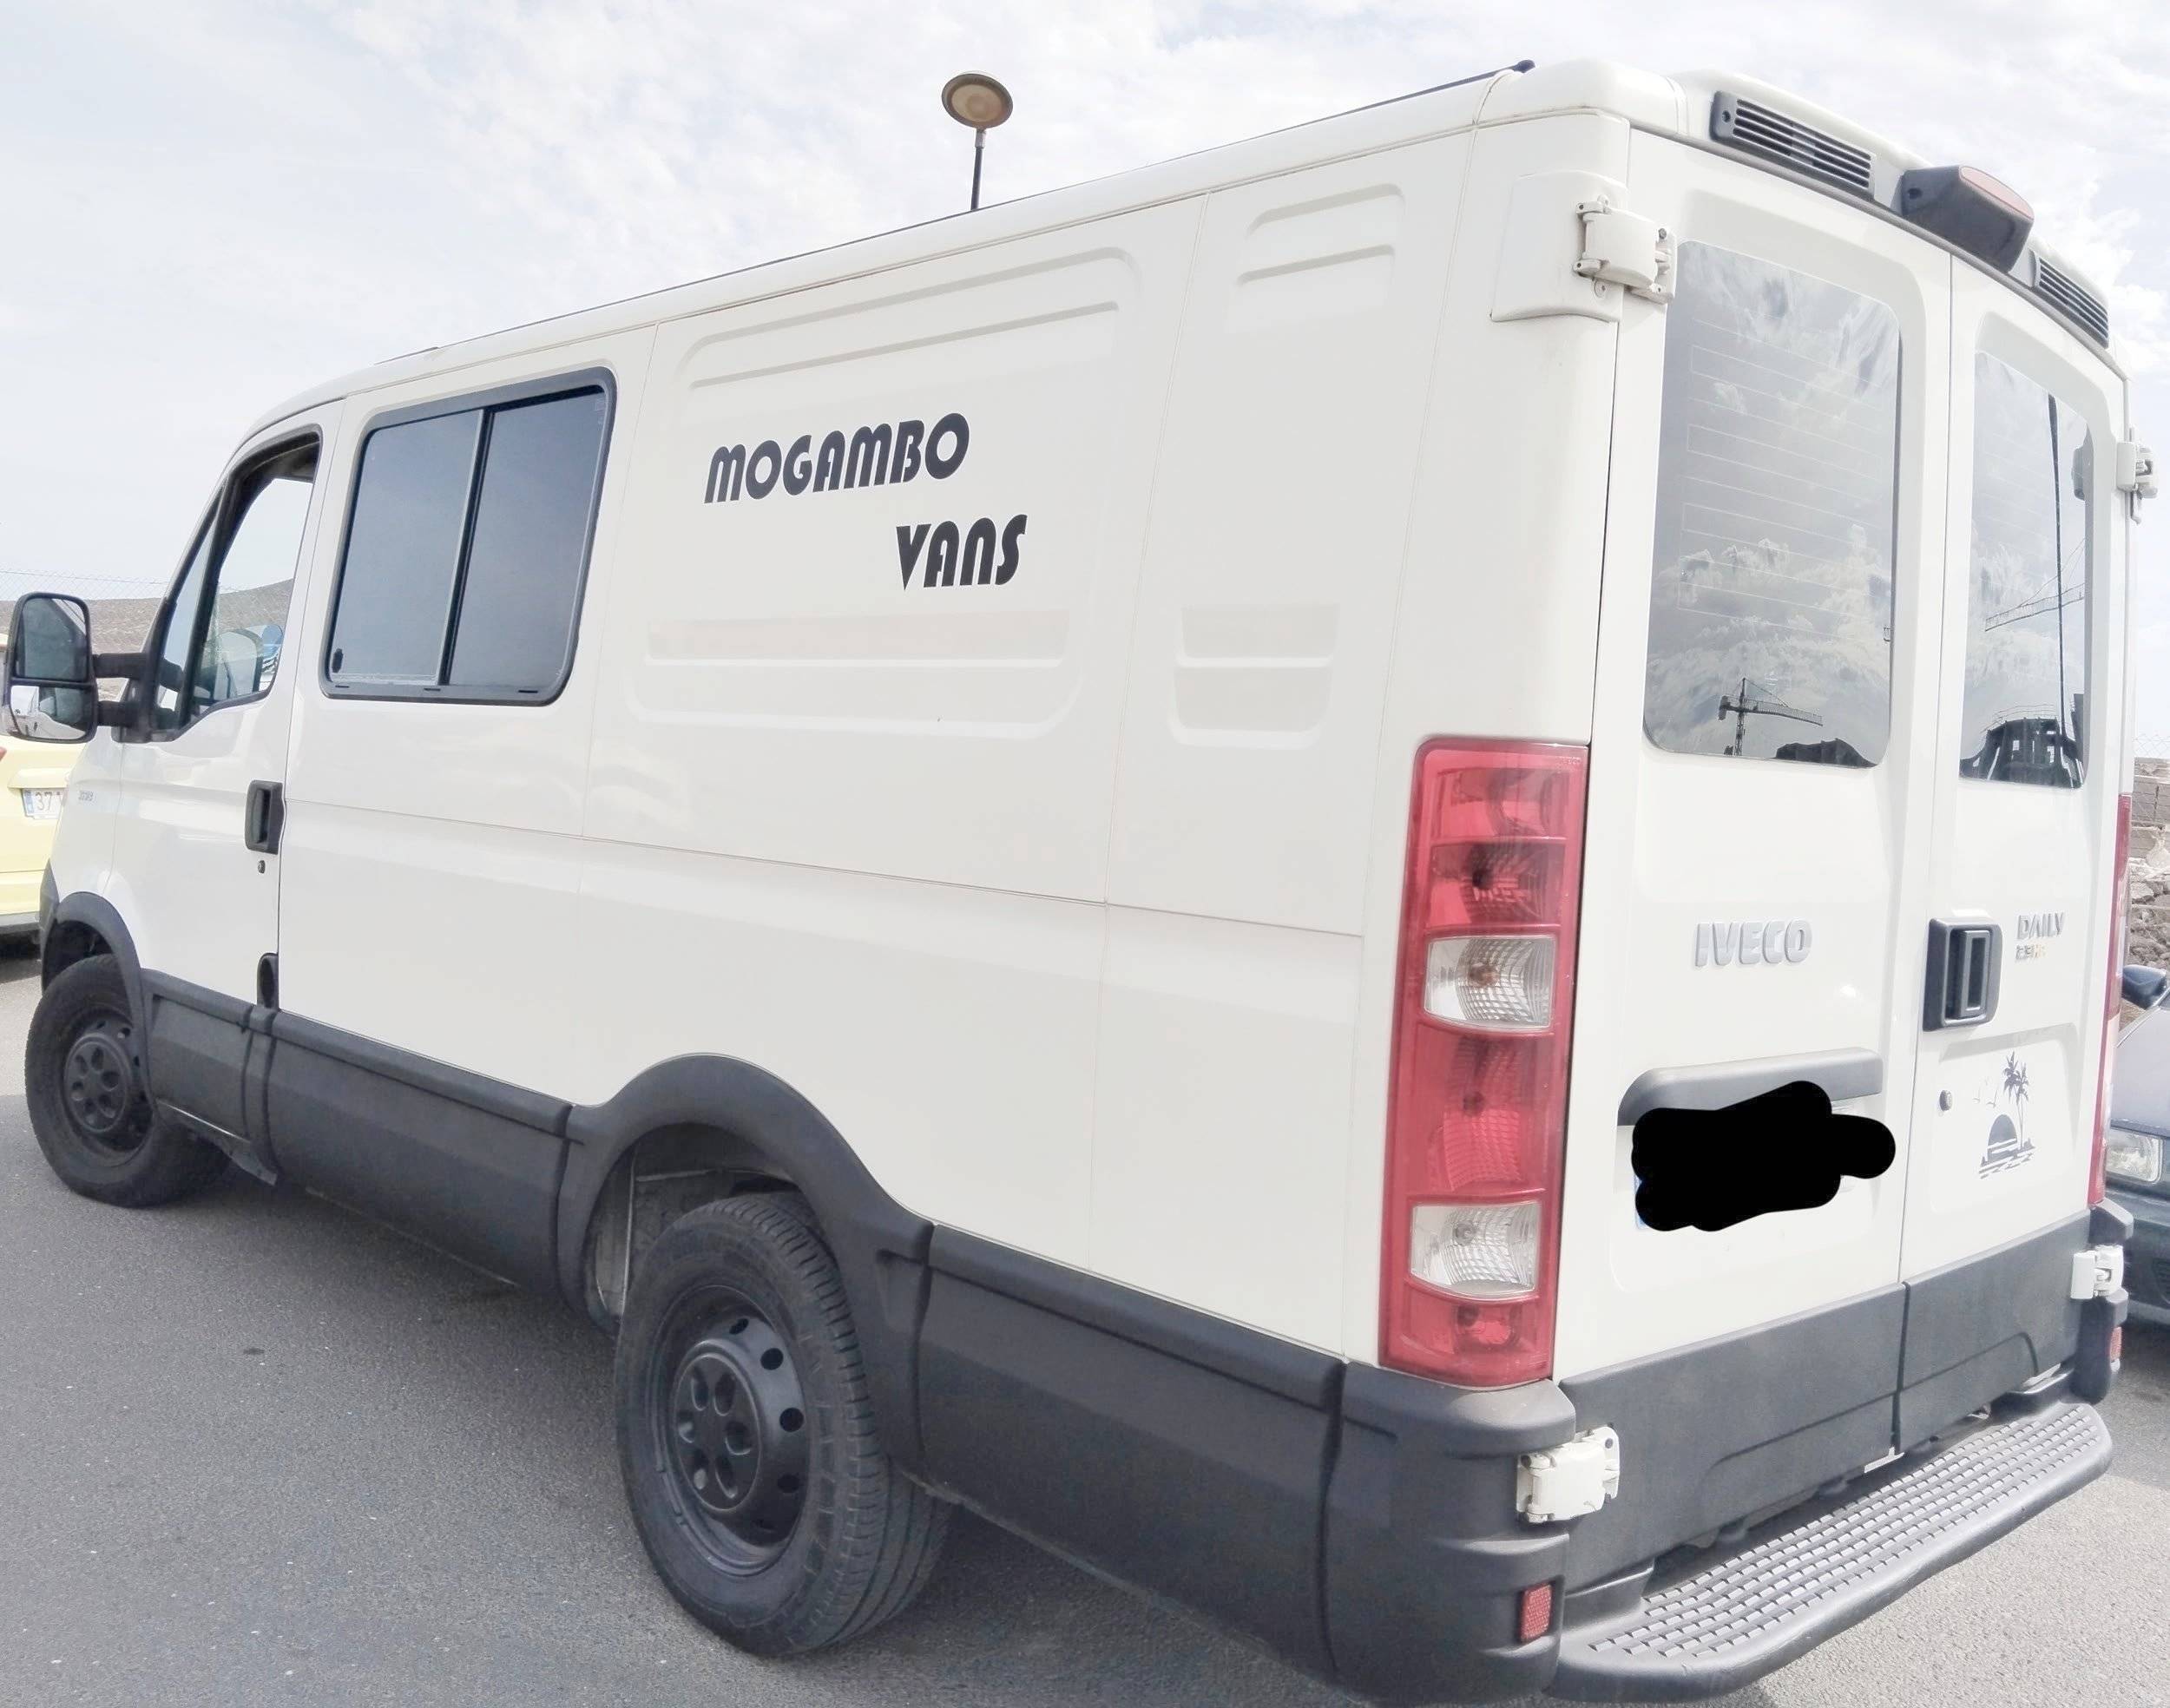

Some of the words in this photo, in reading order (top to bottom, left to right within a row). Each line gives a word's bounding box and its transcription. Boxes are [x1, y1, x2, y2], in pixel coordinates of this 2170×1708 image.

[704, 412, 970, 503] MOGAMBO
[896, 514, 1028, 591] VANS
[1694, 920, 1812, 968] IVECO
[2016, 911, 2064, 940] DAILY
